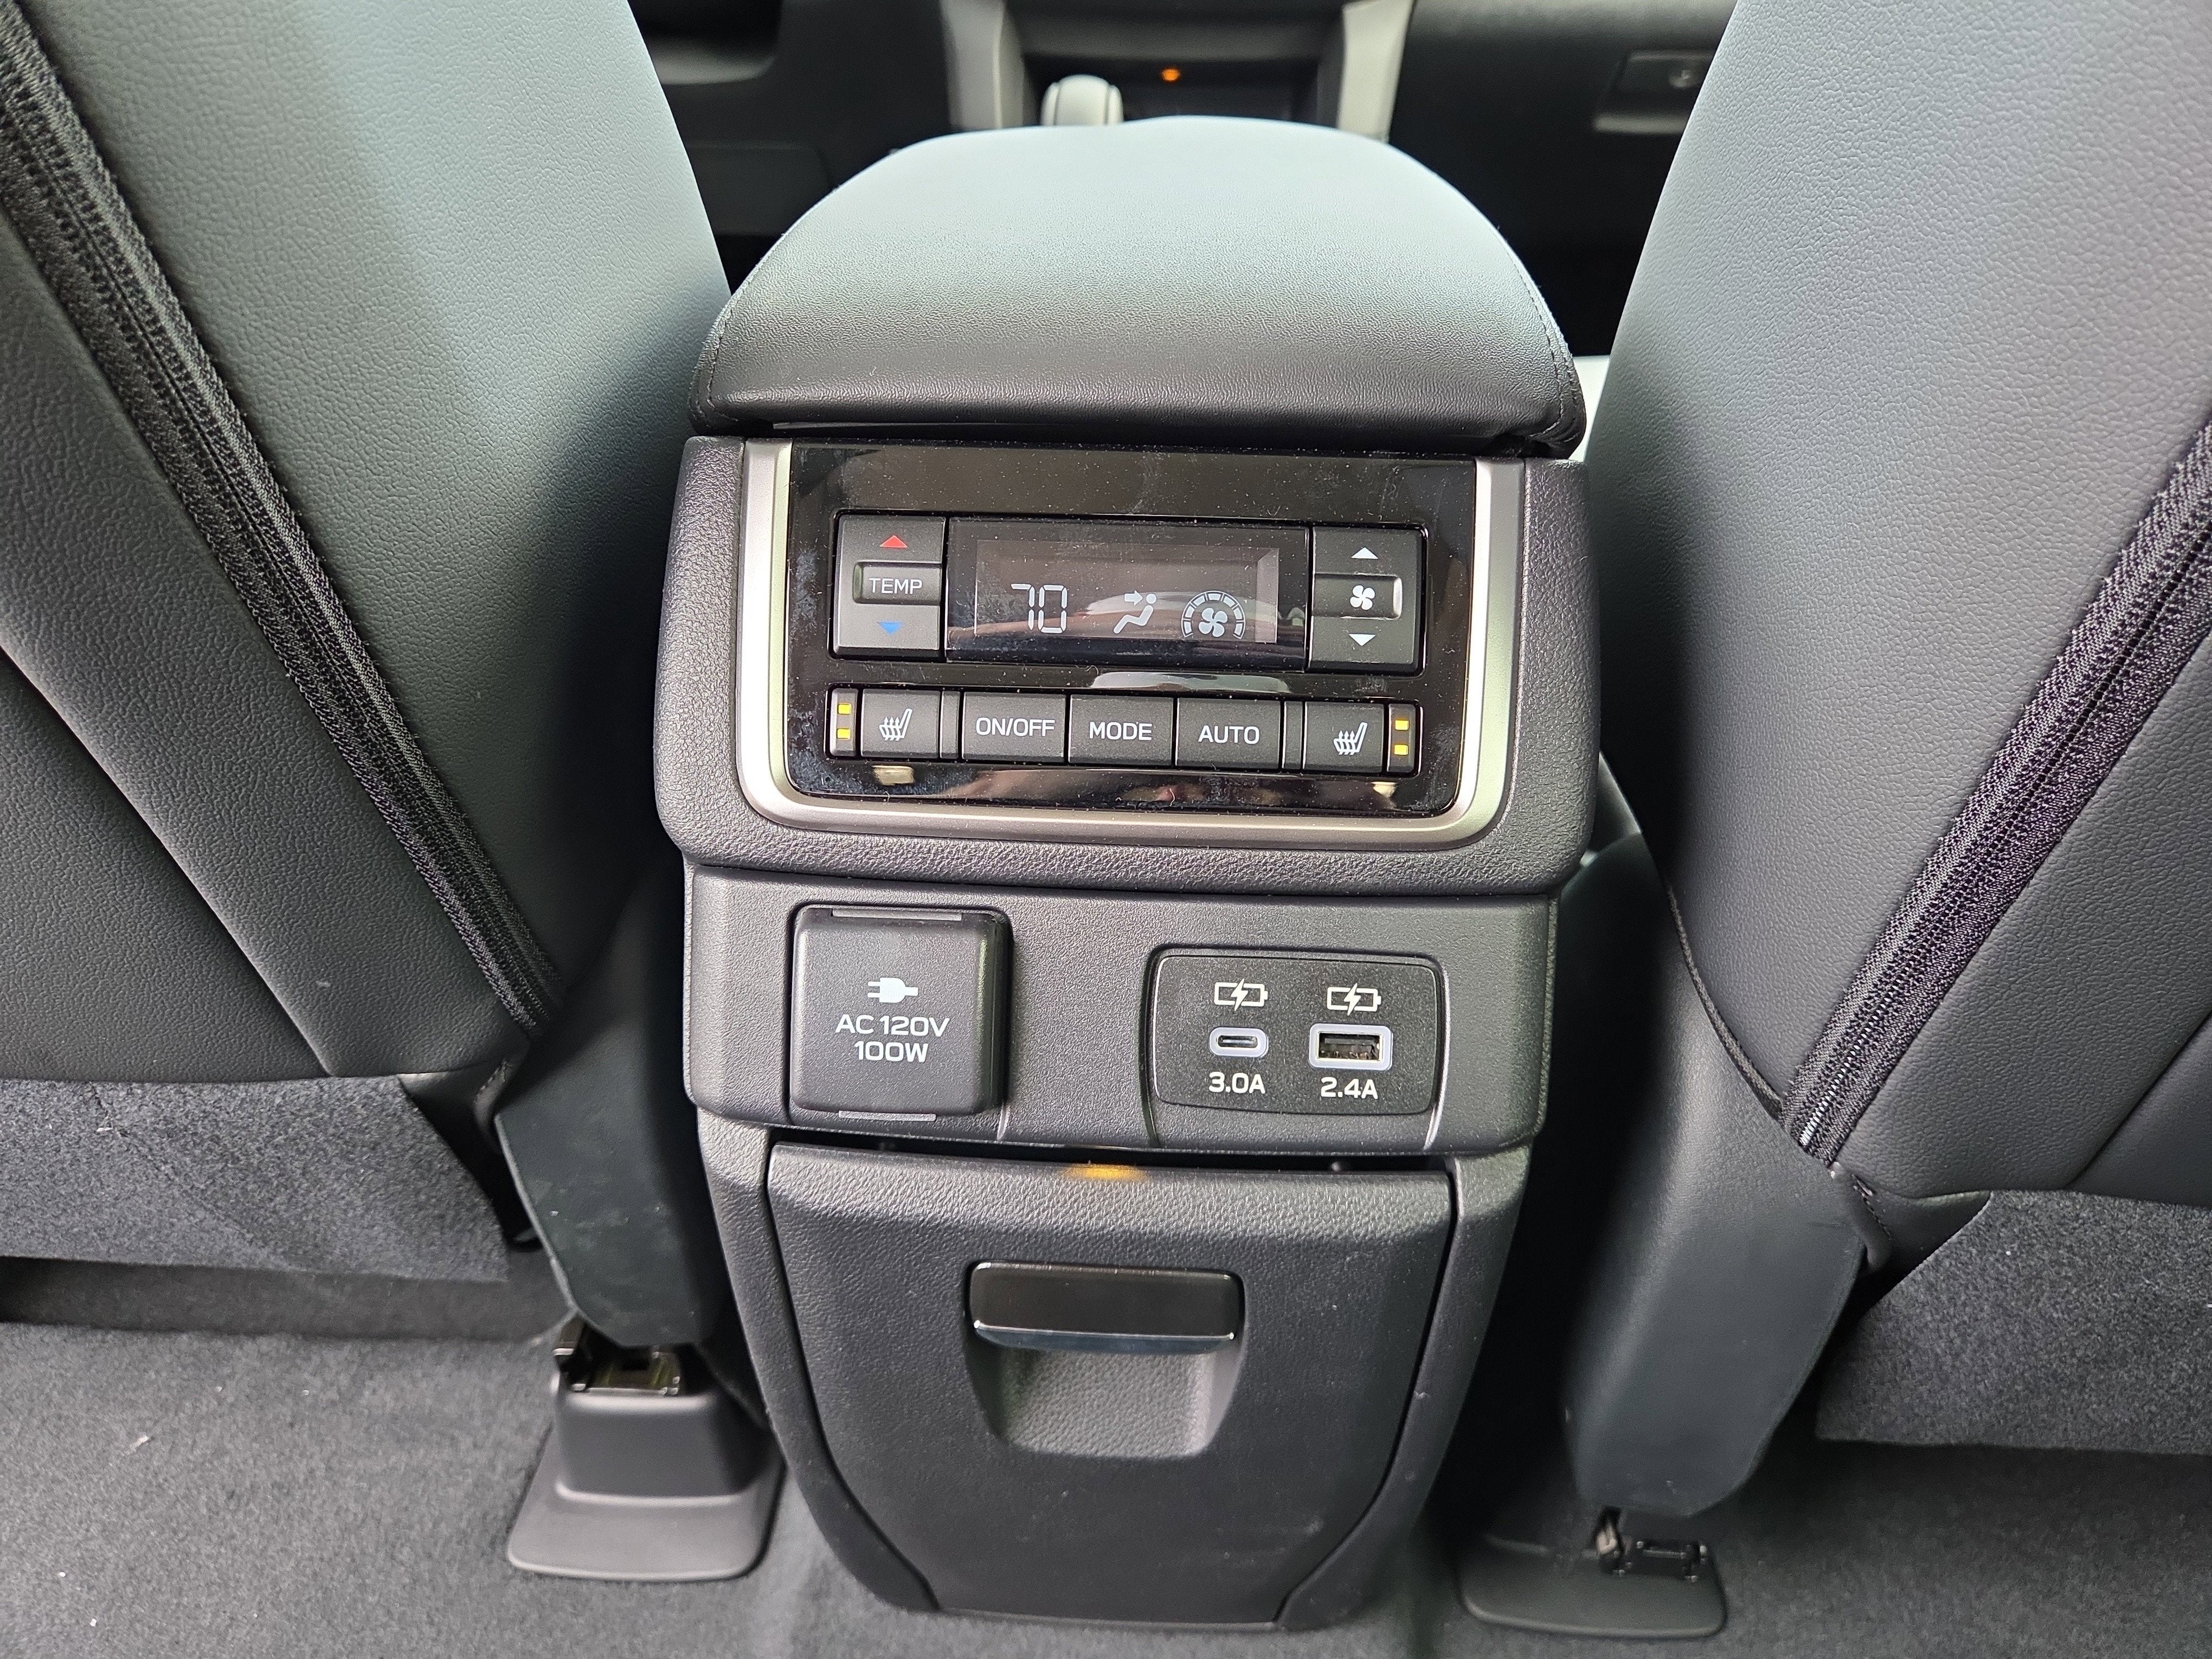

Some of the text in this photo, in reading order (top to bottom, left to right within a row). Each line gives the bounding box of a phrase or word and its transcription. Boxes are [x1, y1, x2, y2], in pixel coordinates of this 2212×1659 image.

[868, 575, 923, 595] TEMP
[1010, 583, 1068, 634] 70
[975, 717, 1056, 737] ON/OFF
[1089, 721, 1153, 741] MODE
[1198, 724, 1260, 745] AUTO
[834, 1013, 950, 1038] AC 120V
[853, 1040, 929, 1063] 100W
[1208, 1071, 1266, 1095] 3.0A
[1320, 1076, 1379, 1100] 2.4A
